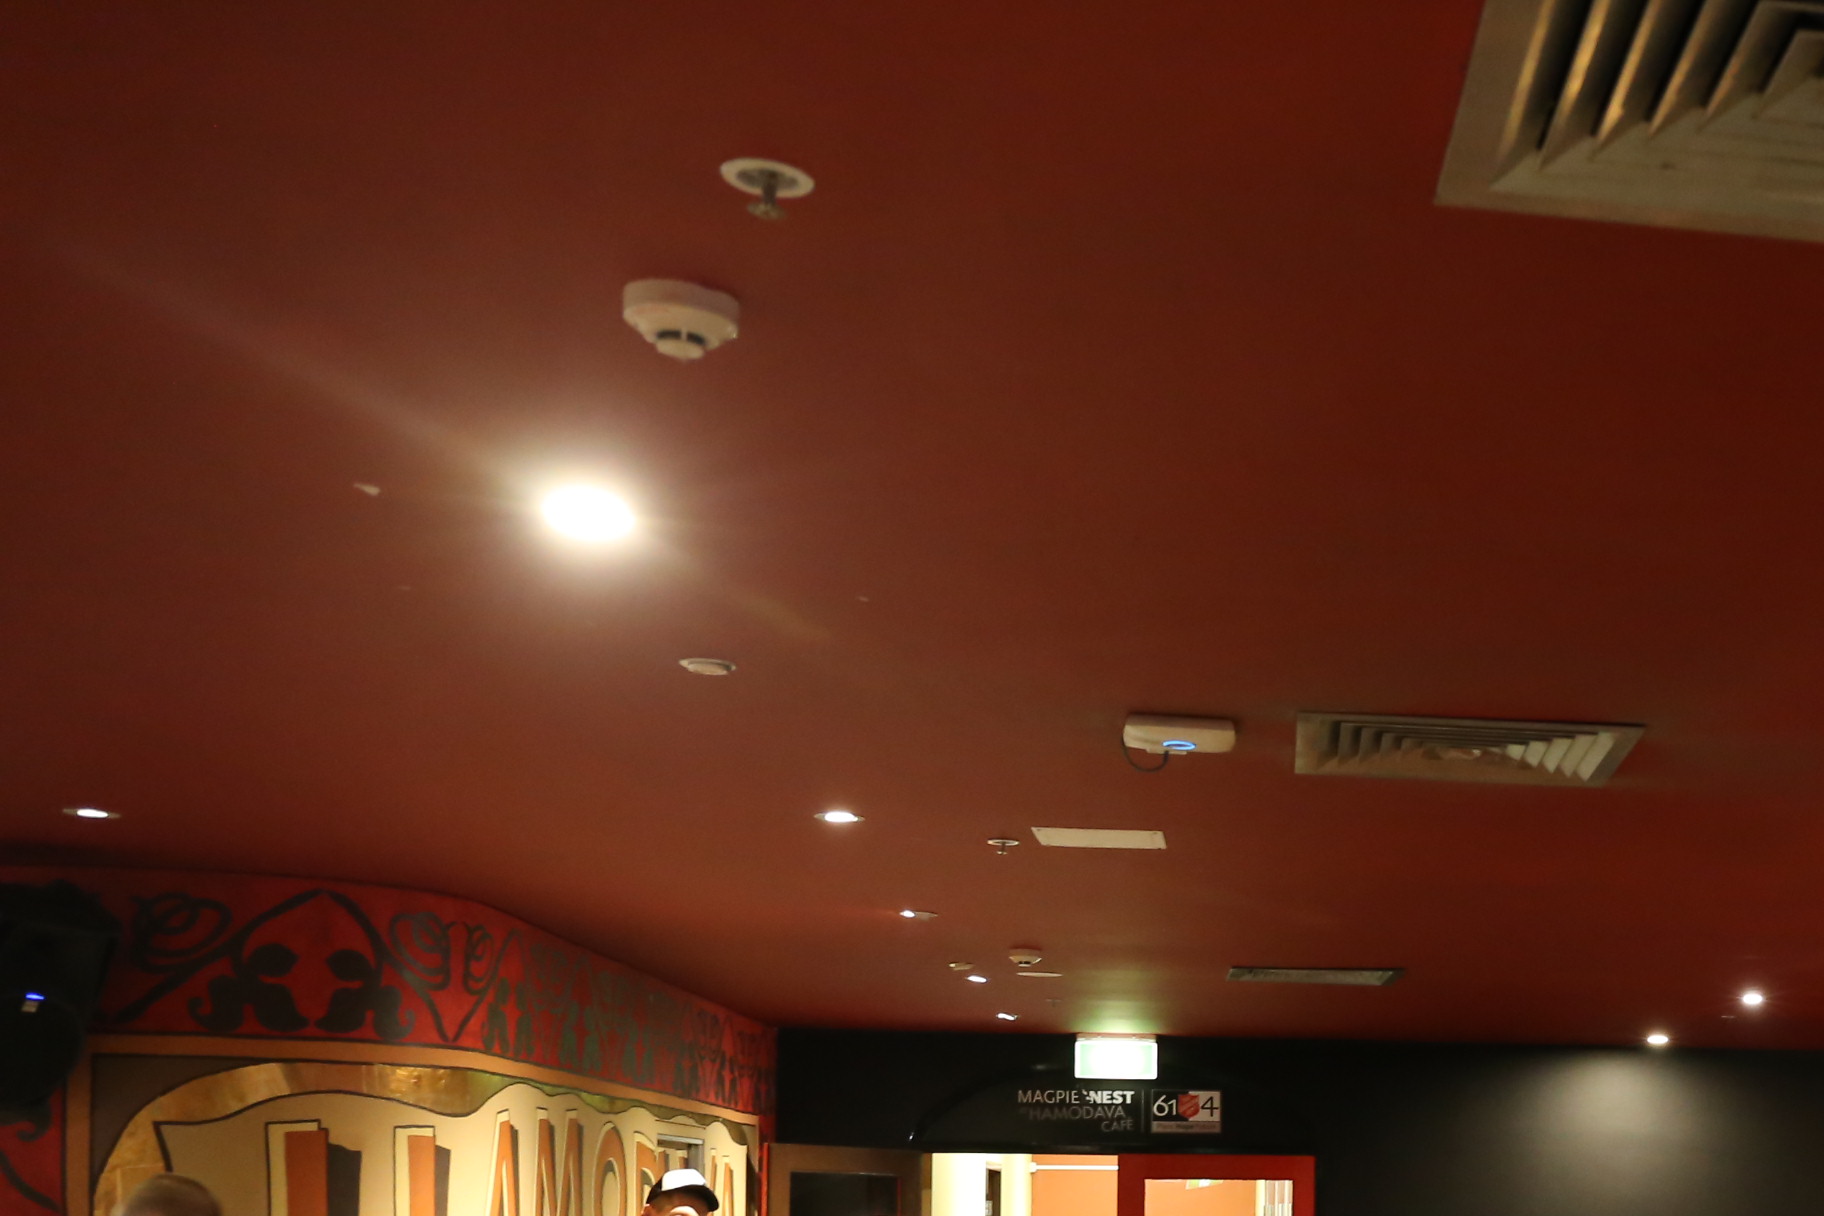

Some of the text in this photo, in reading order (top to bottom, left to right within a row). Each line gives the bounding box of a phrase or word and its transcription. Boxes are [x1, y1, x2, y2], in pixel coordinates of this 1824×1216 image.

[1017, 1089, 1135, 1105] MAGPIE NEST
[1028, 1105, 1126, 1121] HAMODAVA
